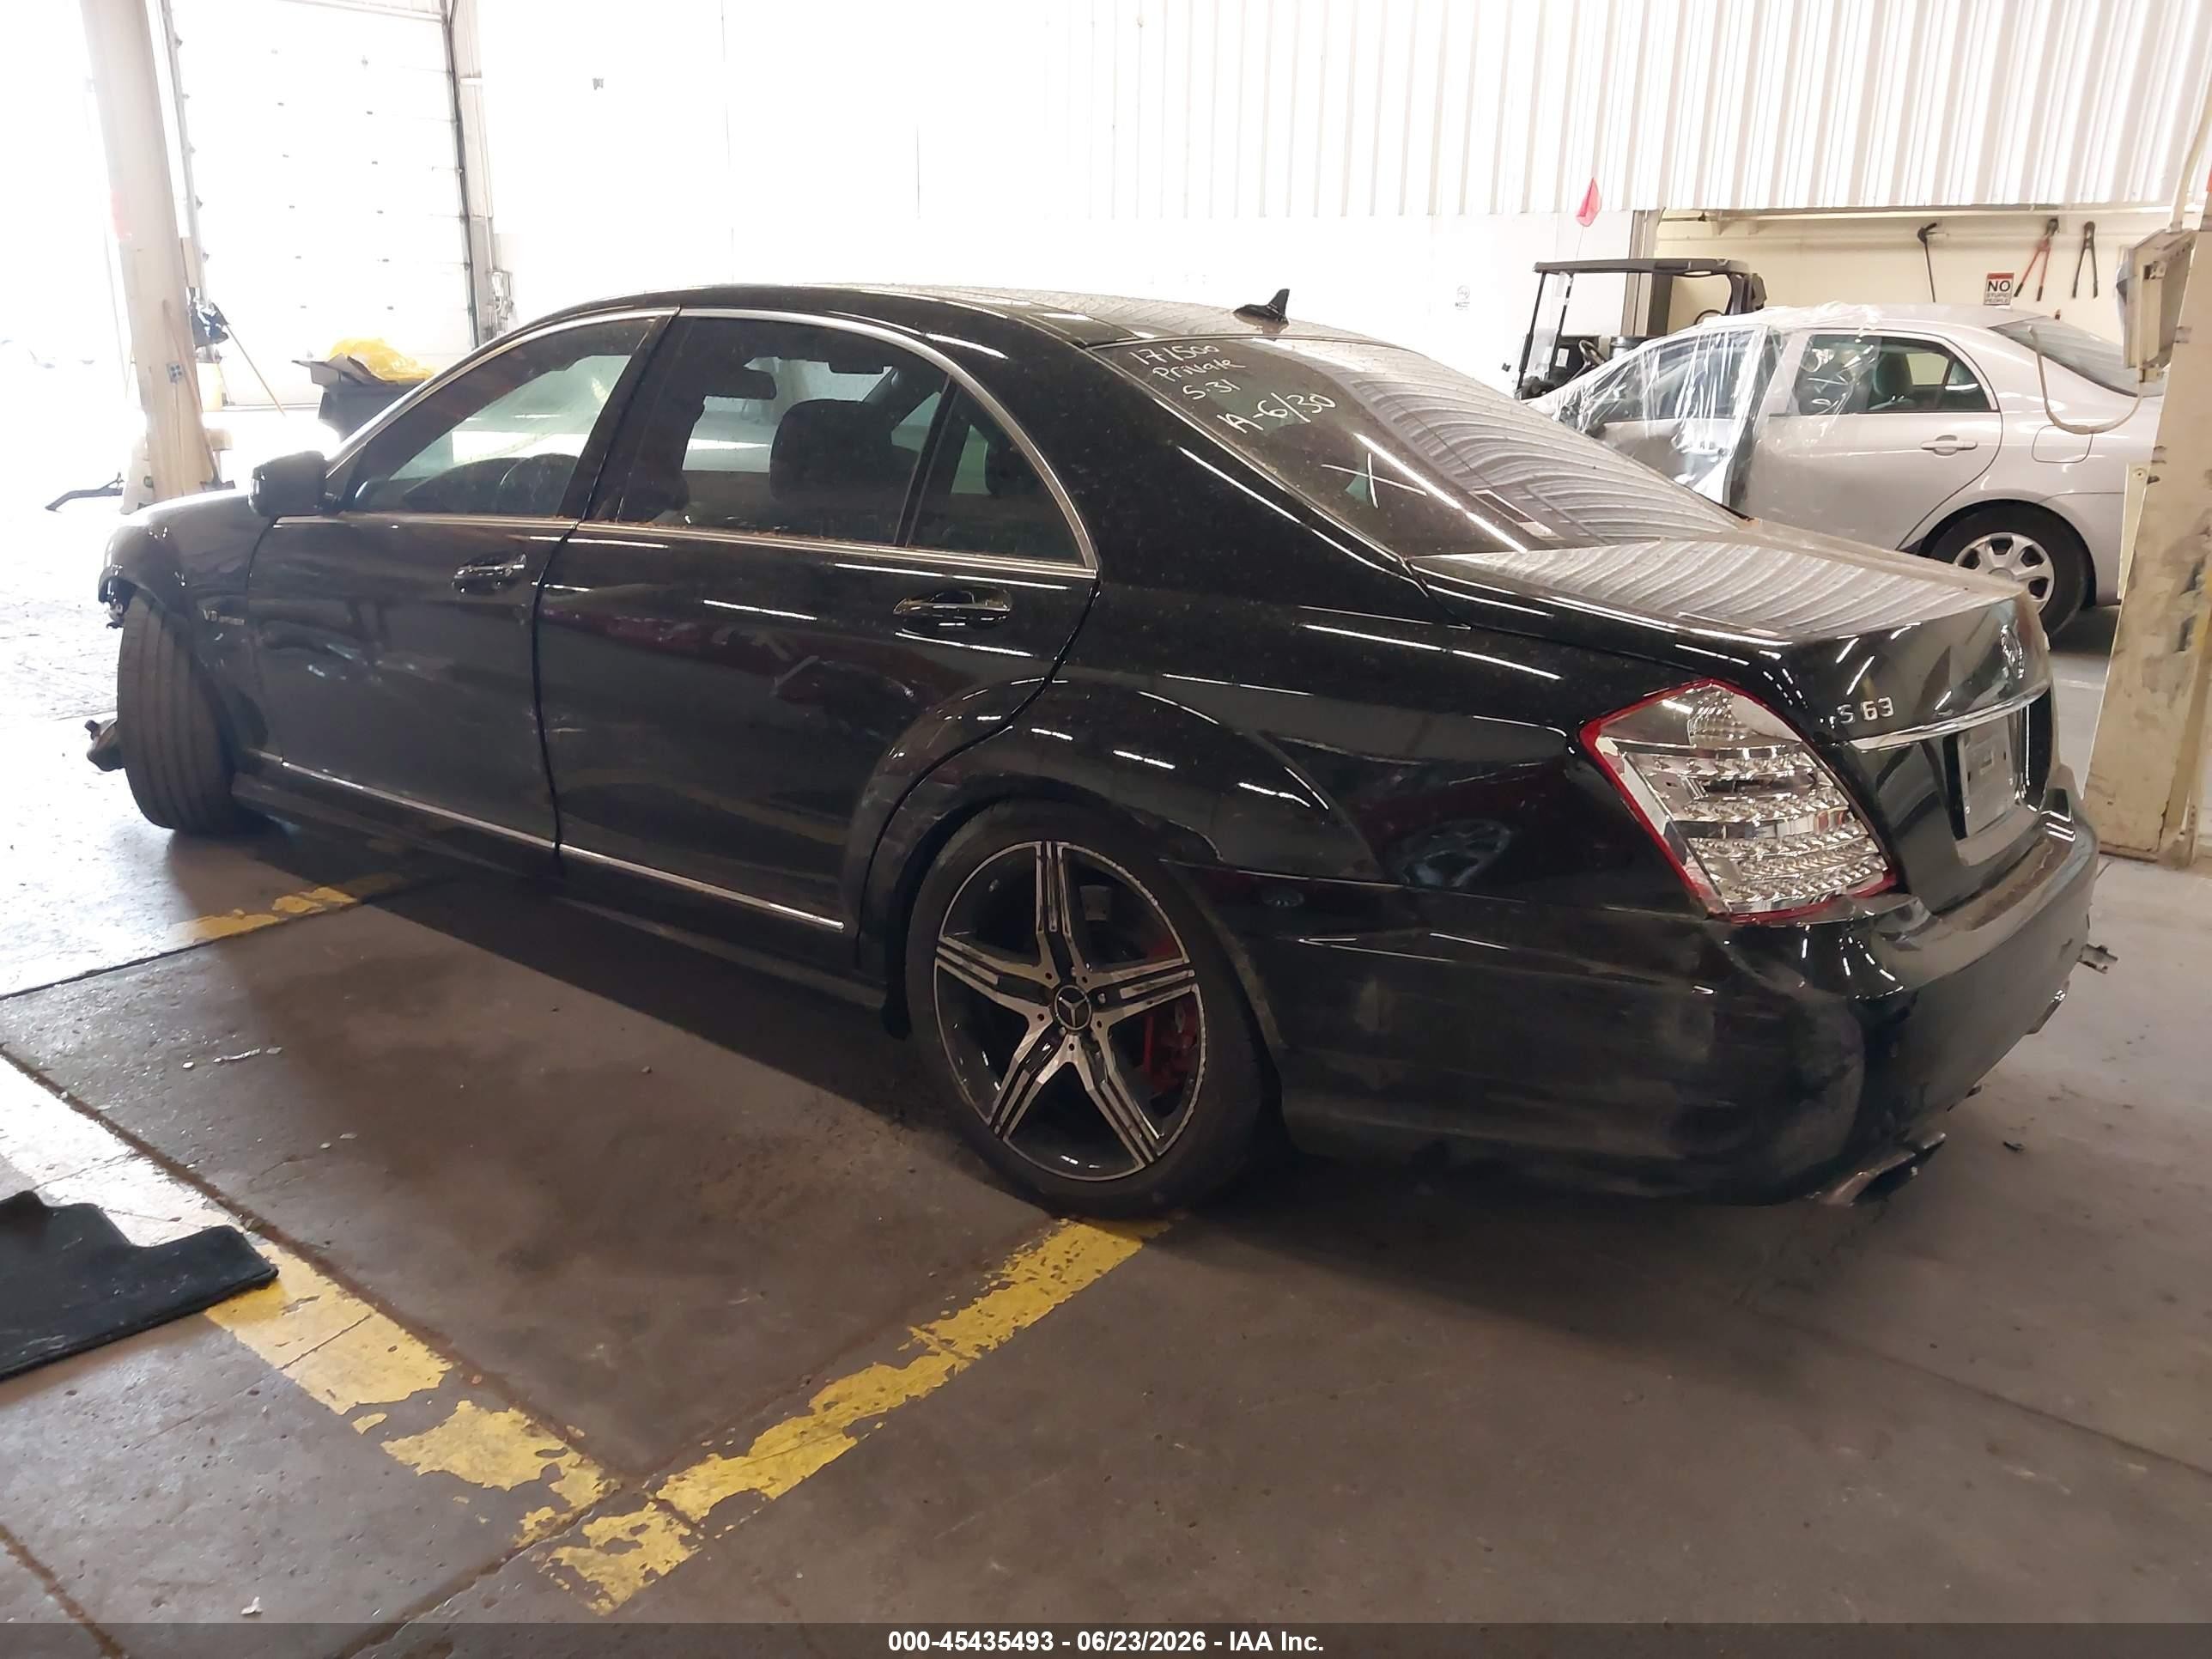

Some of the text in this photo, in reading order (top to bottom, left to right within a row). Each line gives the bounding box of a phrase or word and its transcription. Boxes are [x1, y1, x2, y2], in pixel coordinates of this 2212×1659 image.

[1987, 280, 2011, 292] NO
[1152, 358, 1246, 383] Private
[1837, 696, 1894, 725] S 63
